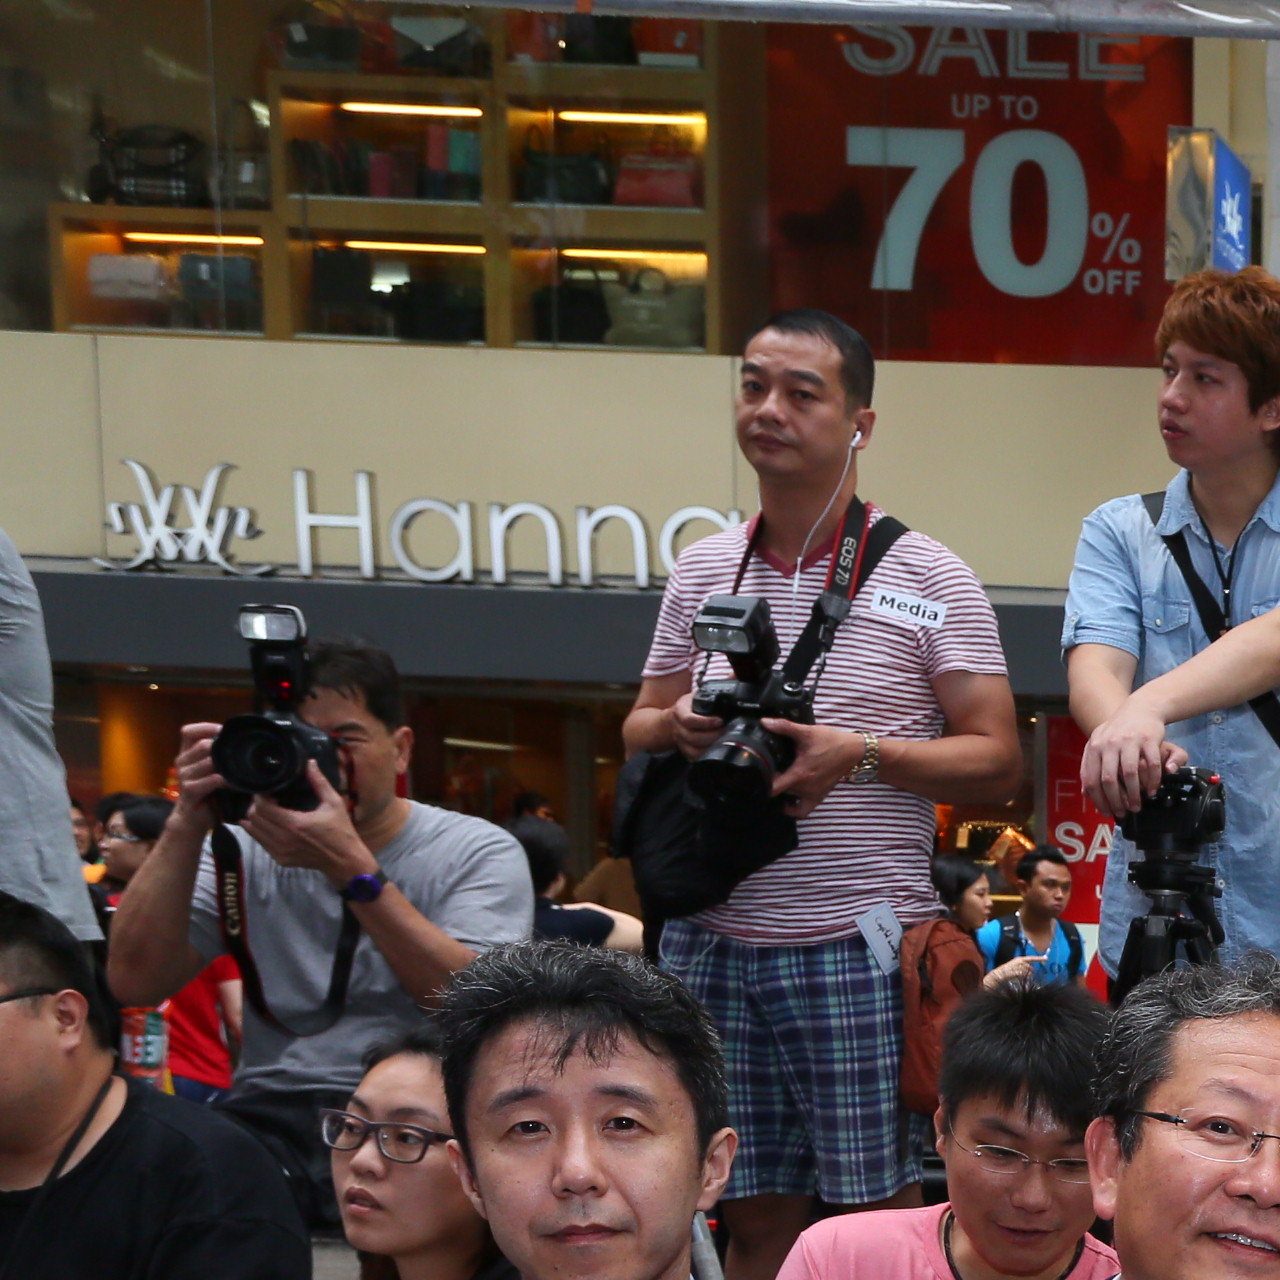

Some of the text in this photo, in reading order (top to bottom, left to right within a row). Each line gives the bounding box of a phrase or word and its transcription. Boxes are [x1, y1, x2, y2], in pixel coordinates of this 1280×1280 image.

[840, 26, 1145, 82] SALE
[951, 95, 1039, 121] UP TO
[1083, 270, 1142, 295] OFF
[838, 536, 857, 568] EOS
[878, 594, 939, 622] Media
